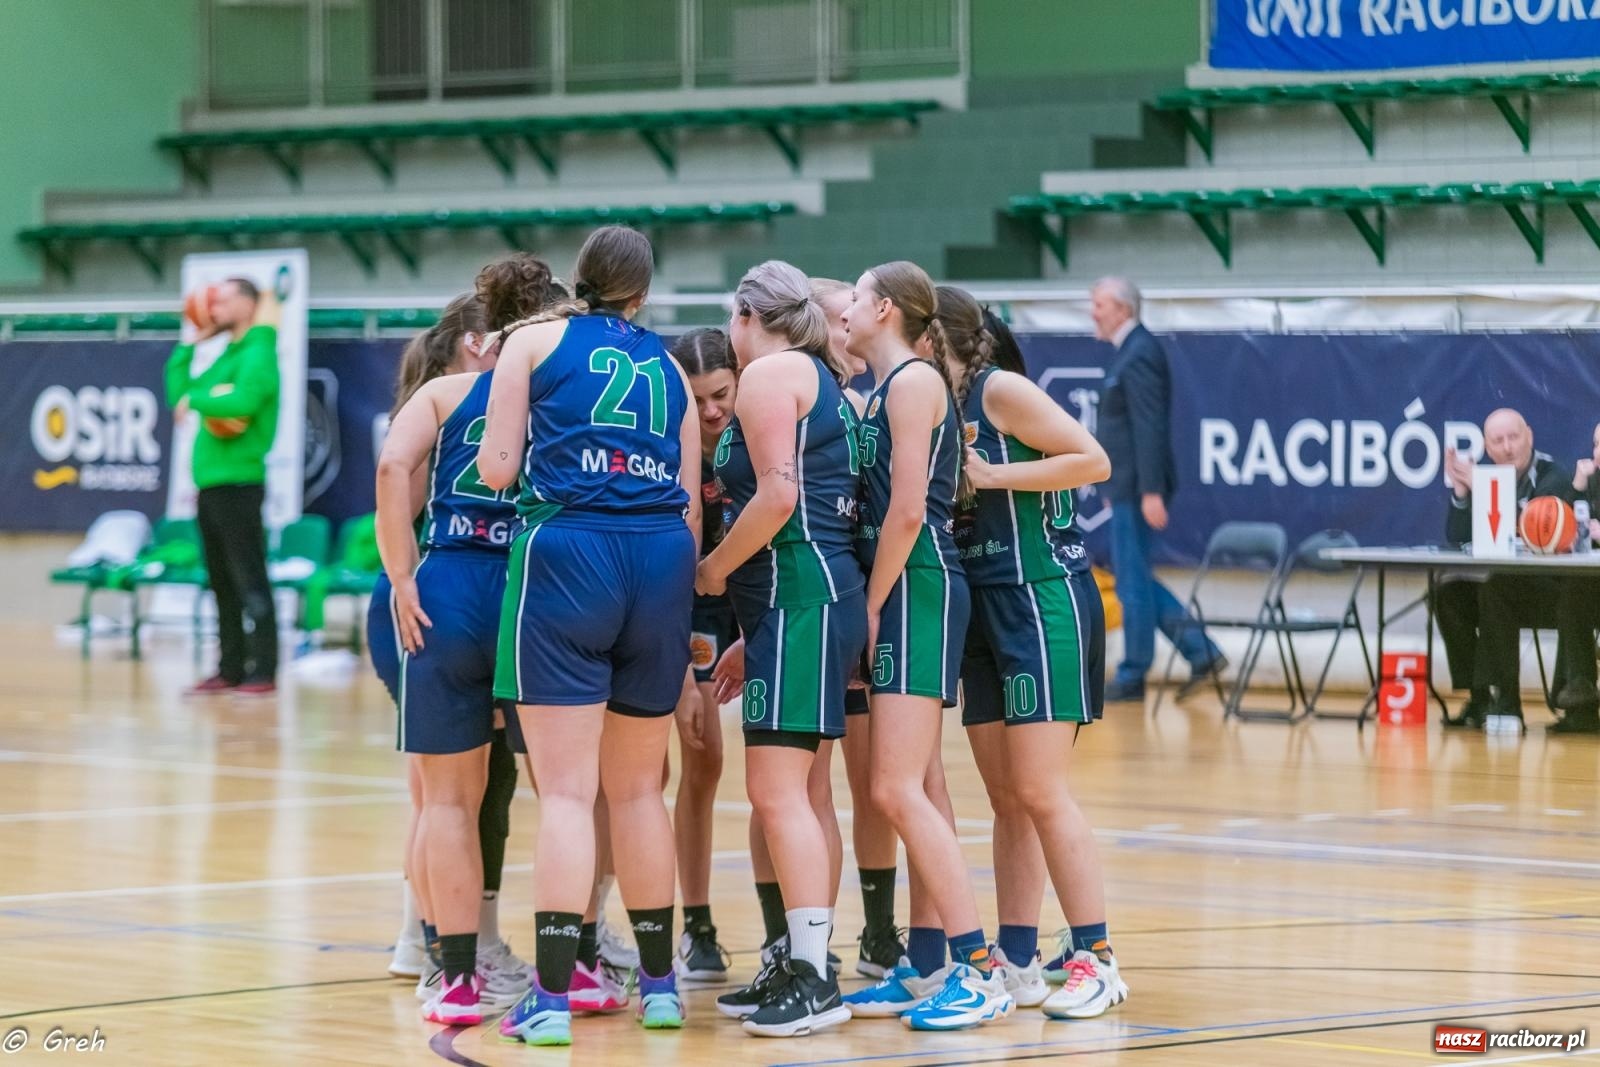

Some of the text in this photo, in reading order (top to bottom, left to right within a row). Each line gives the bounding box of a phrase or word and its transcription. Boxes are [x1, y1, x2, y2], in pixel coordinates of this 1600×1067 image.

[589, 346, 668, 438] 21
[874, 643, 894, 687] 5
[1386, 656, 1417, 710] 5
[743, 678, 767, 723] 8
[1003, 673, 1038, 718] 10
